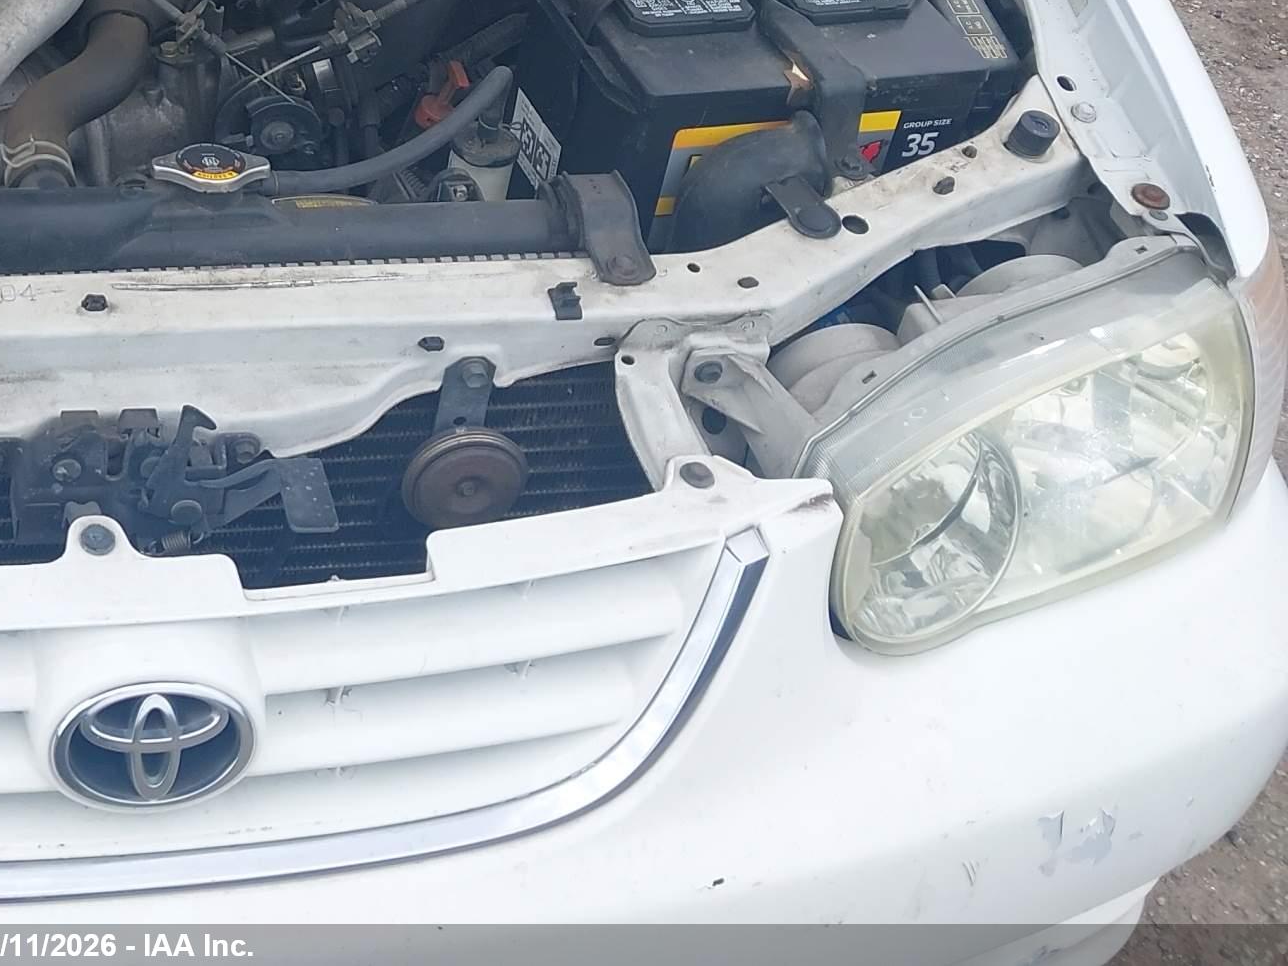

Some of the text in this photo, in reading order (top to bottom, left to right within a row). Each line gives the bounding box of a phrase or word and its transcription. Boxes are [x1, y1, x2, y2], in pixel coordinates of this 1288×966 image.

[903, 118, 953, 130] GROUP SIZE
[901, 132, 939, 157] 35
